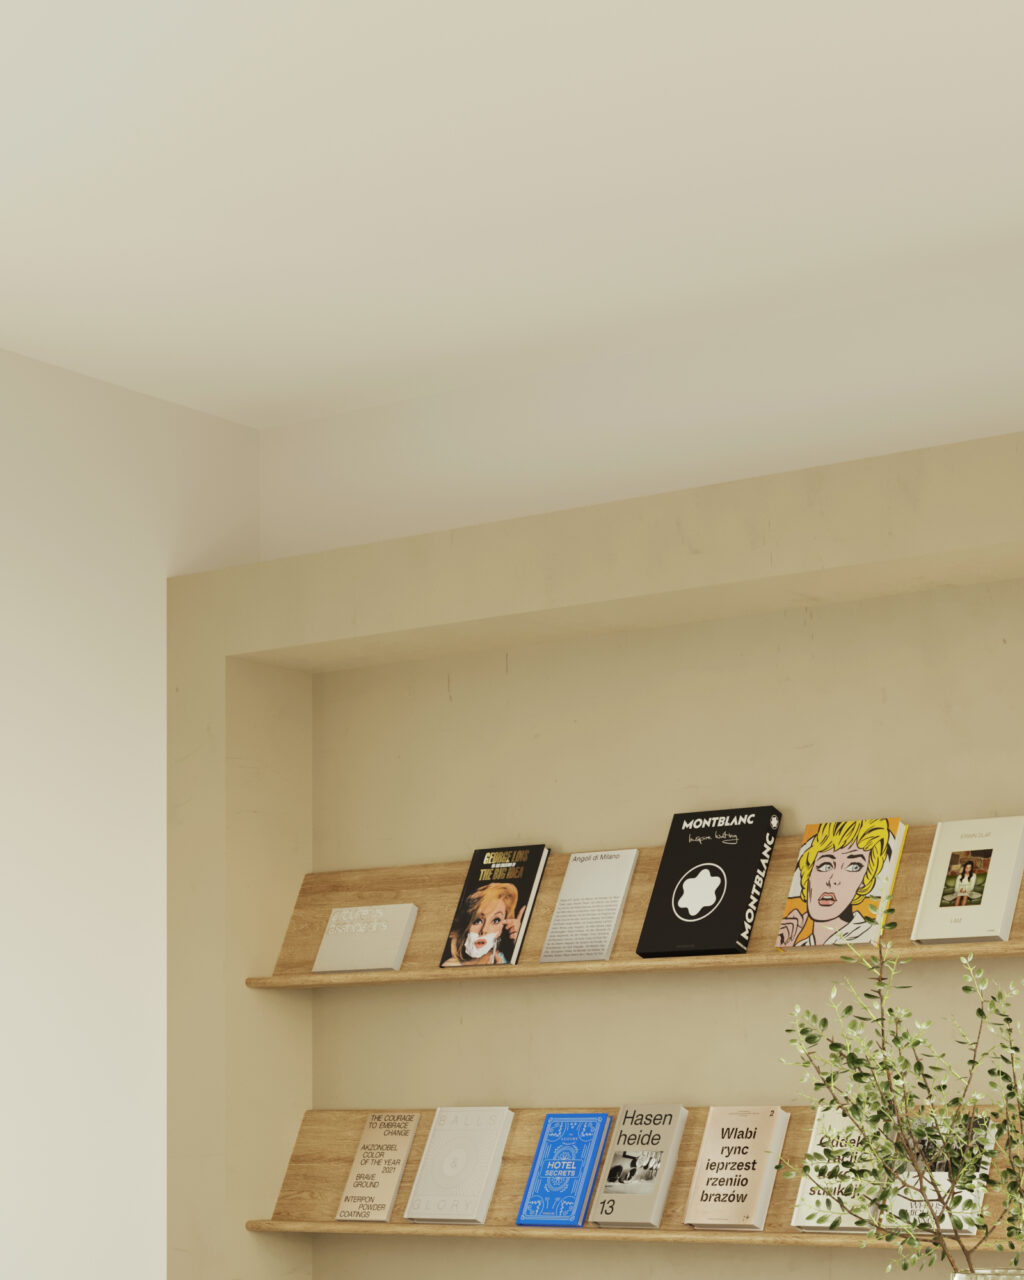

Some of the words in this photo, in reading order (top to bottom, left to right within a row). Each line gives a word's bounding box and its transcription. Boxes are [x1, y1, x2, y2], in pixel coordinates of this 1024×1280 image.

[681, 814, 755, 830] MONTBLANC
[740, 832, 775, 940] MONTBLANC
[622, 1110, 673, 1126] Hasen
[617, 1130, 661, 1146] heide
[720, 1145, 749, 1158] rync
[547, 1161, 577, 1169] HOTEL
[705, 1159, 758, 1173] ieprzest
[544, 1169, 576, 1177] SECRETS
[705, 1175, 749, 1187] rzeniio
[700, 1190, 748, 1203] brazów
[599, 1199, 615, 1216] 13
